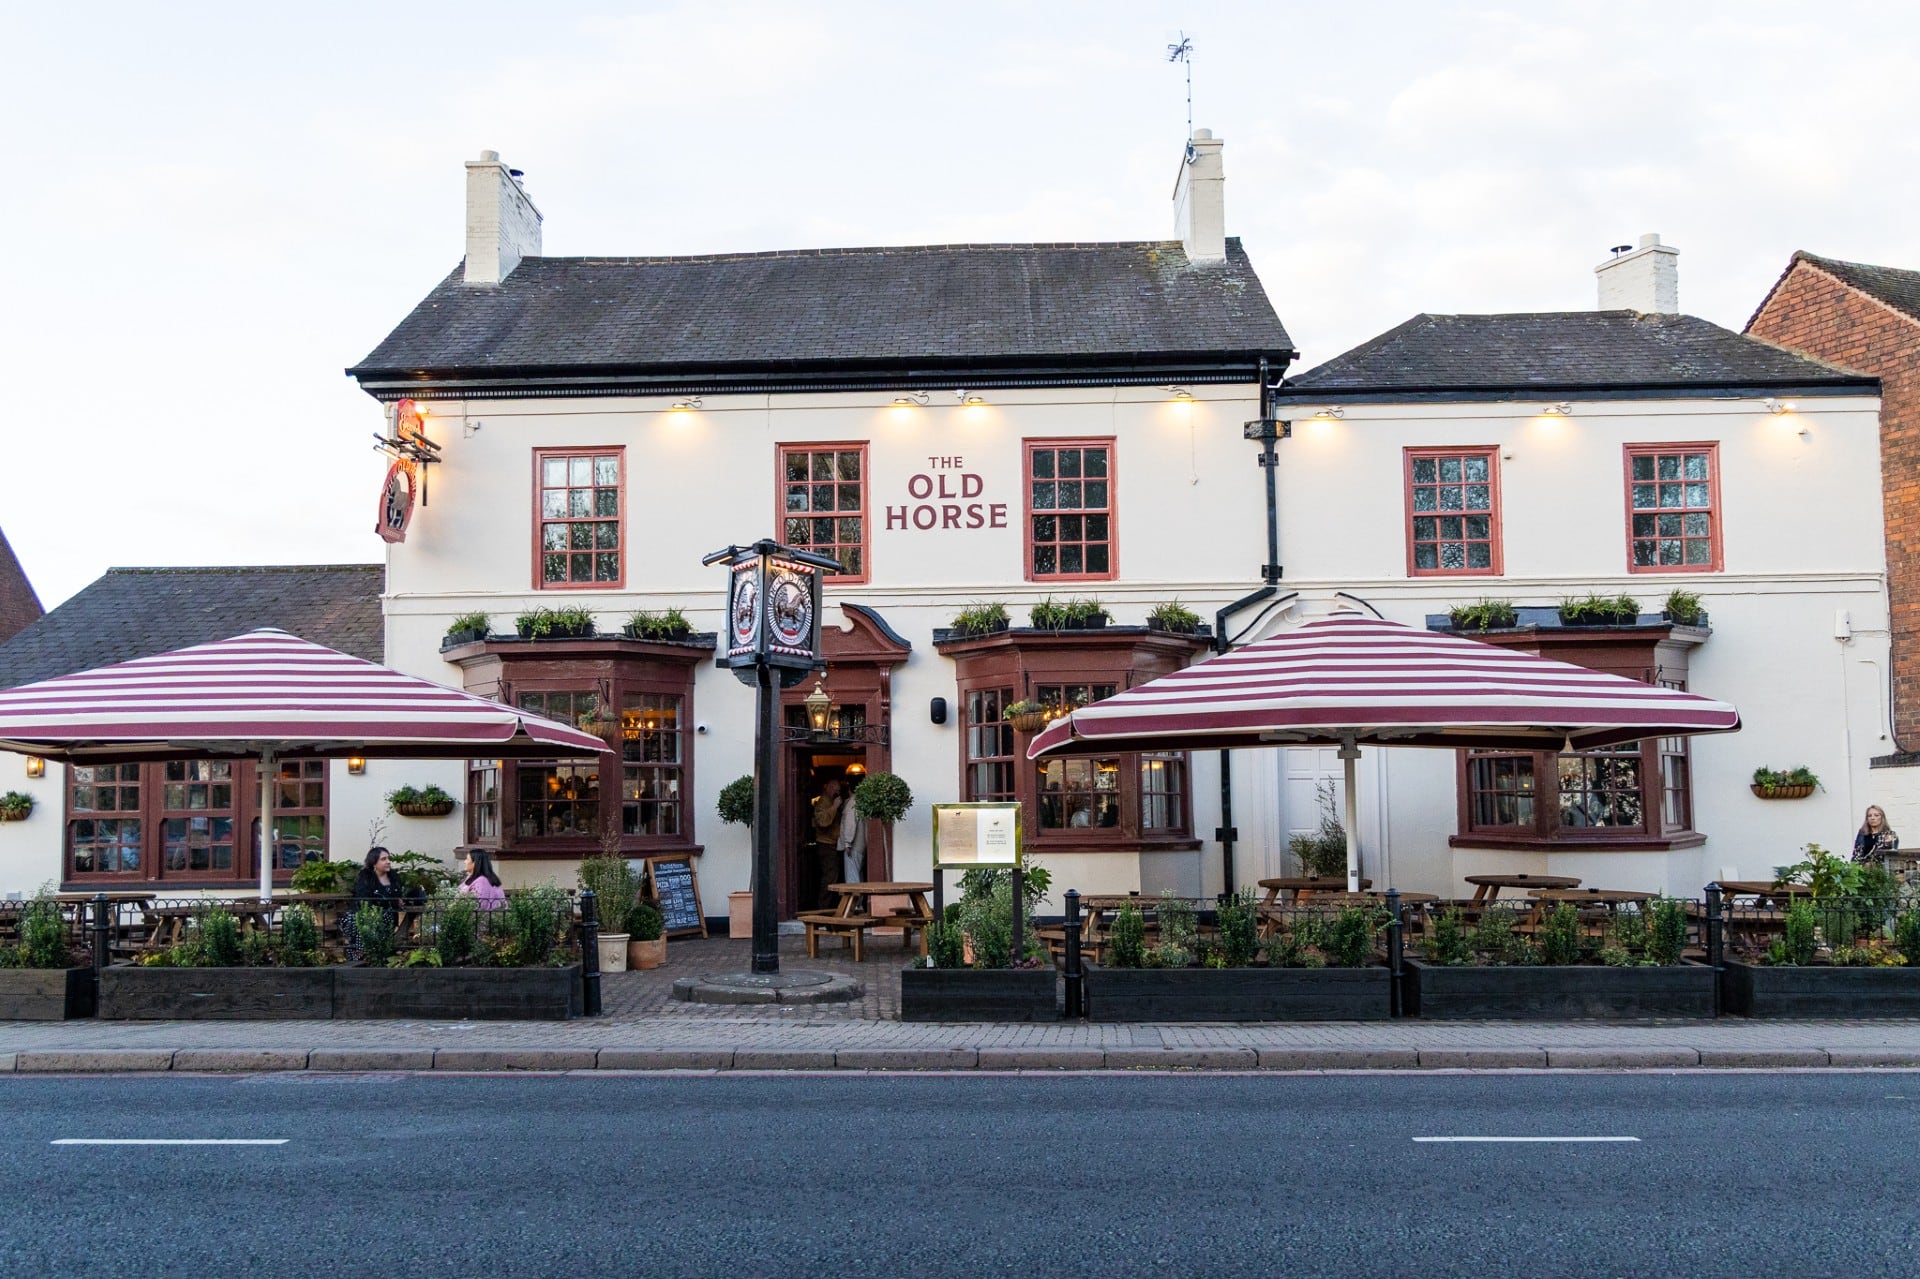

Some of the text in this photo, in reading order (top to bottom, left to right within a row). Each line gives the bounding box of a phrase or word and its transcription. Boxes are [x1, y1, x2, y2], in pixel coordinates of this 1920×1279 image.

[928, 456, 963, 469] THE
[908, 473, 984, 499] OLD
[885, 504, 1008, 530] HORSE
[778, 572, 794, 583] OLD
